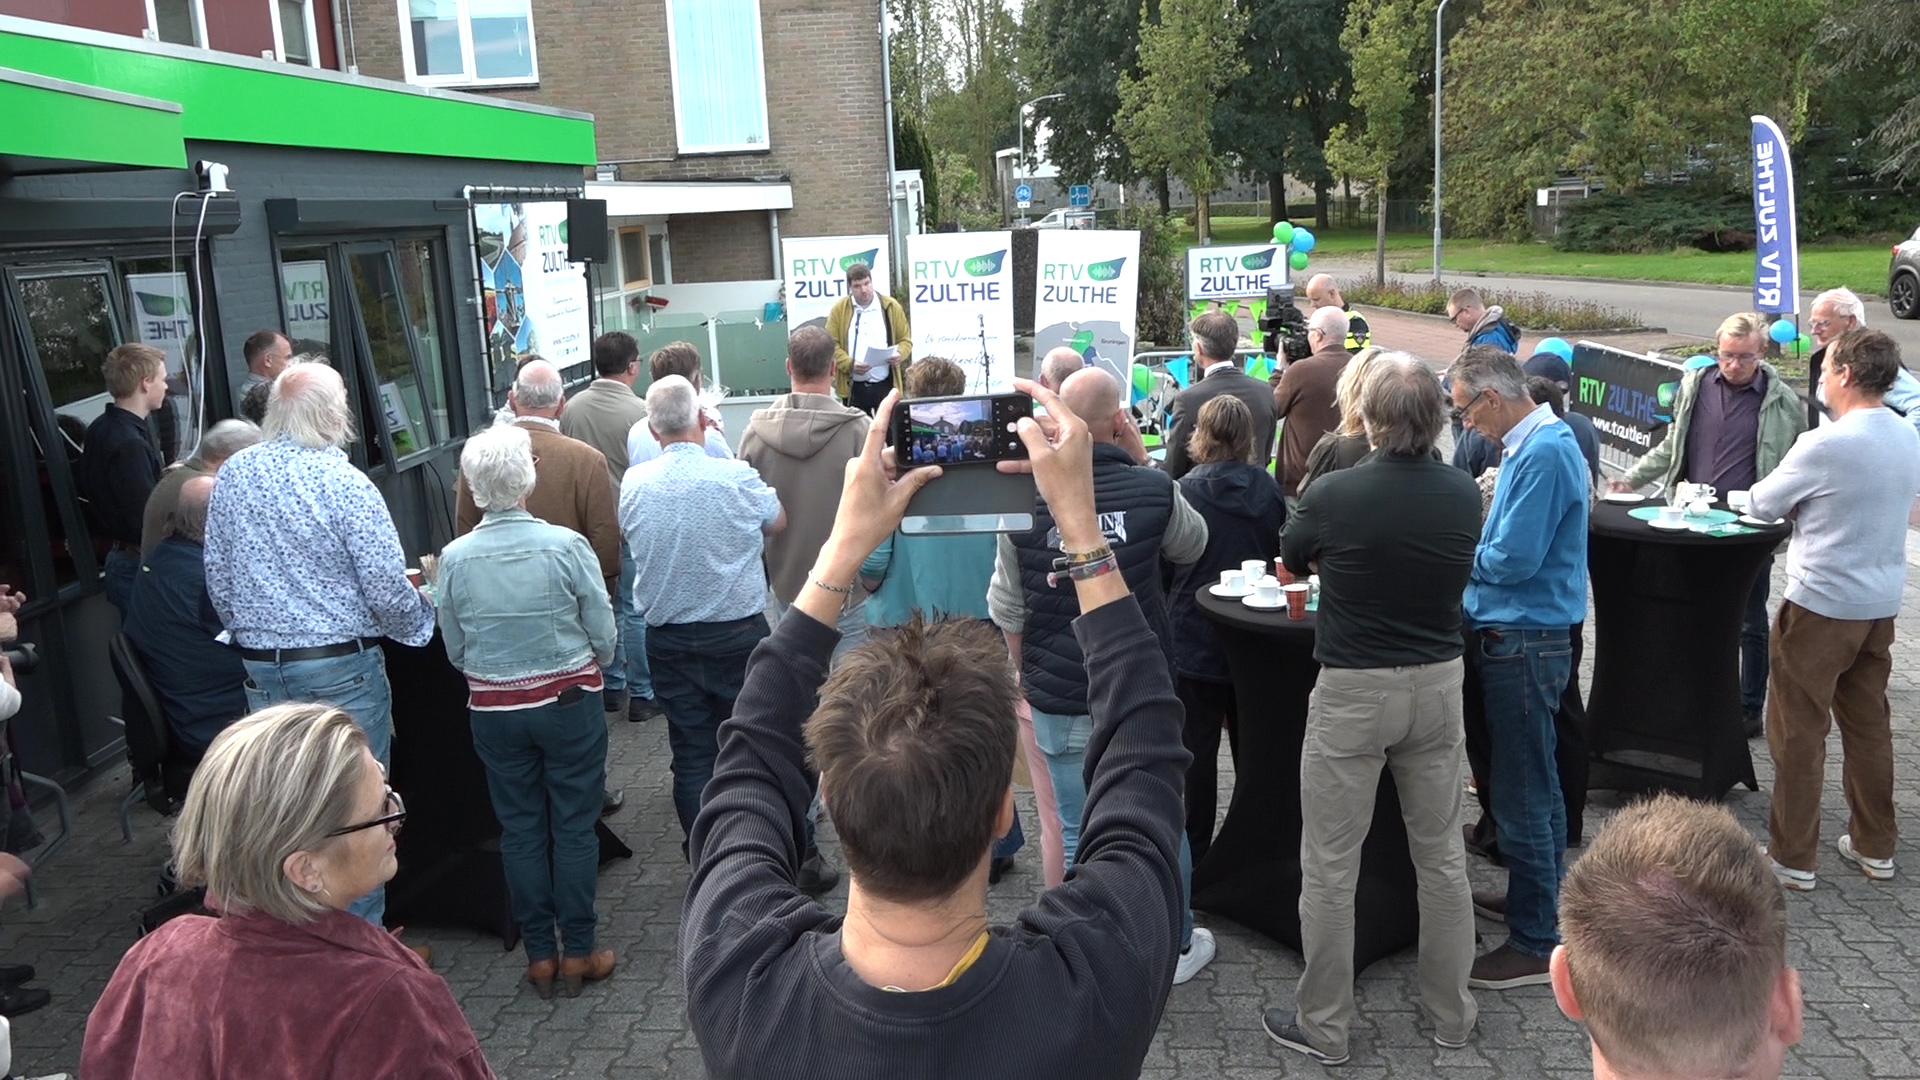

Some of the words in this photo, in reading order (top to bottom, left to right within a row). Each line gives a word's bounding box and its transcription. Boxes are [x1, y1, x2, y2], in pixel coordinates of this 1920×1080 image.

[539, 224, 557, 246] RTV
[793, 257, 835, 276] RTV
[914, 260, 960, 279] RTV
[1043, 263, 1083, 281] RTV
[1200, 256, 1238, 273] RTV
[795, 279, 849, 298] ZULT
[915, 281, 1000, 303] ZULTHE
[1200, 274, 1270, 292] ZULTHE
[1043, 285, 1117, 304] ZULTHE
[1579, 376, 1606, 407] RTV
[1607, 384, 1657, 424] ZULTHE
